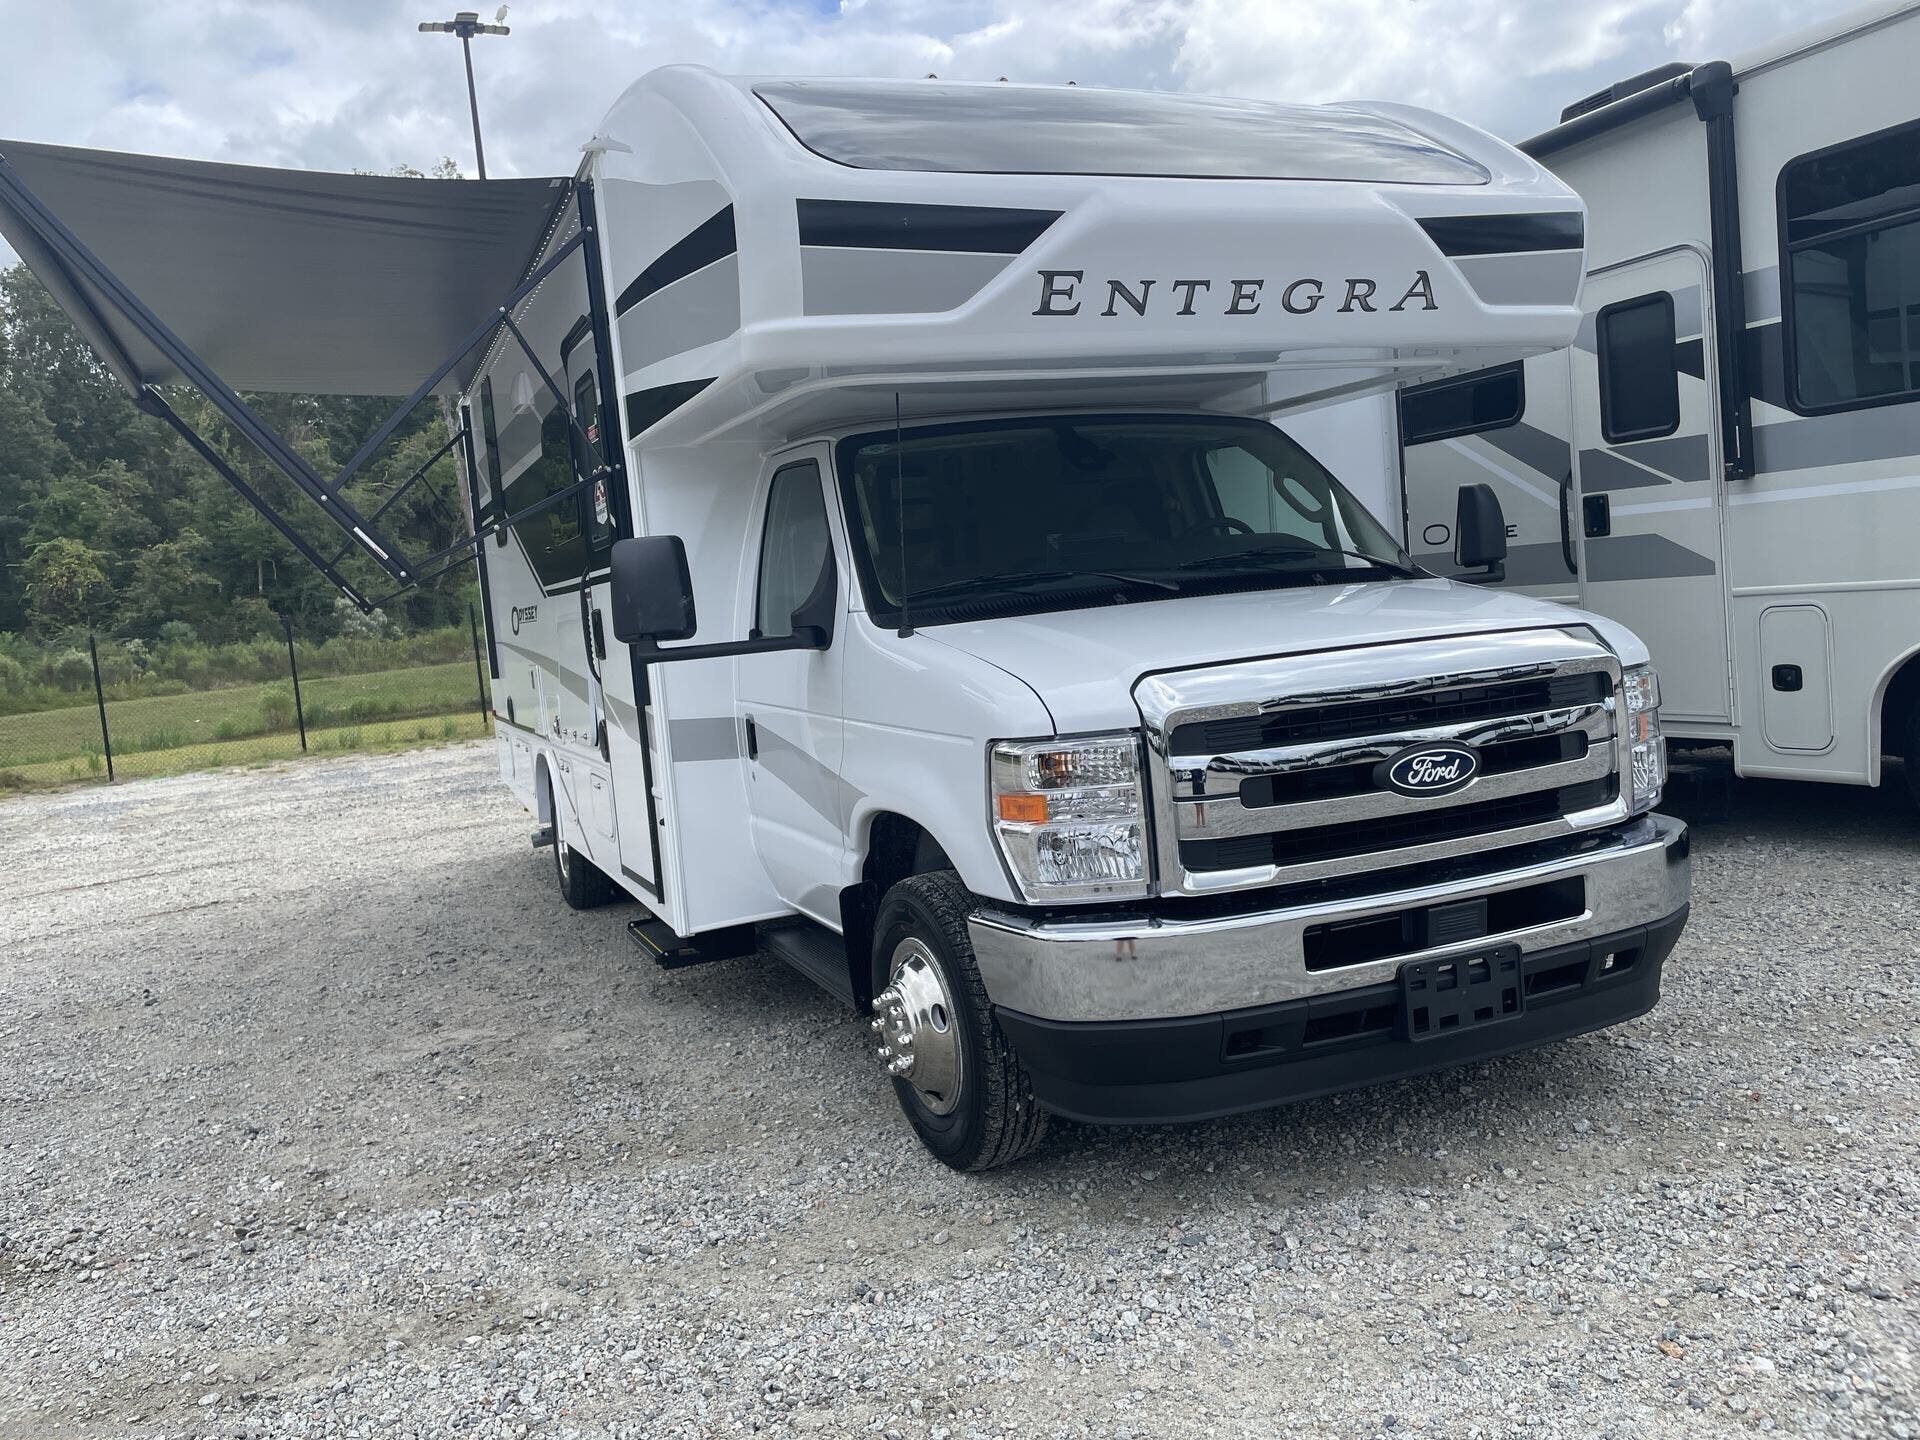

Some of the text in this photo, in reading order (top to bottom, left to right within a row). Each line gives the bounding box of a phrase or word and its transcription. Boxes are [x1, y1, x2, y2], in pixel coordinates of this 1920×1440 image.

[1031, 269, 1439, 317] ENTEGRA
[511, 605, 538, 636] ODYSSEY
[1407, 754, 1460, 785] Ford
